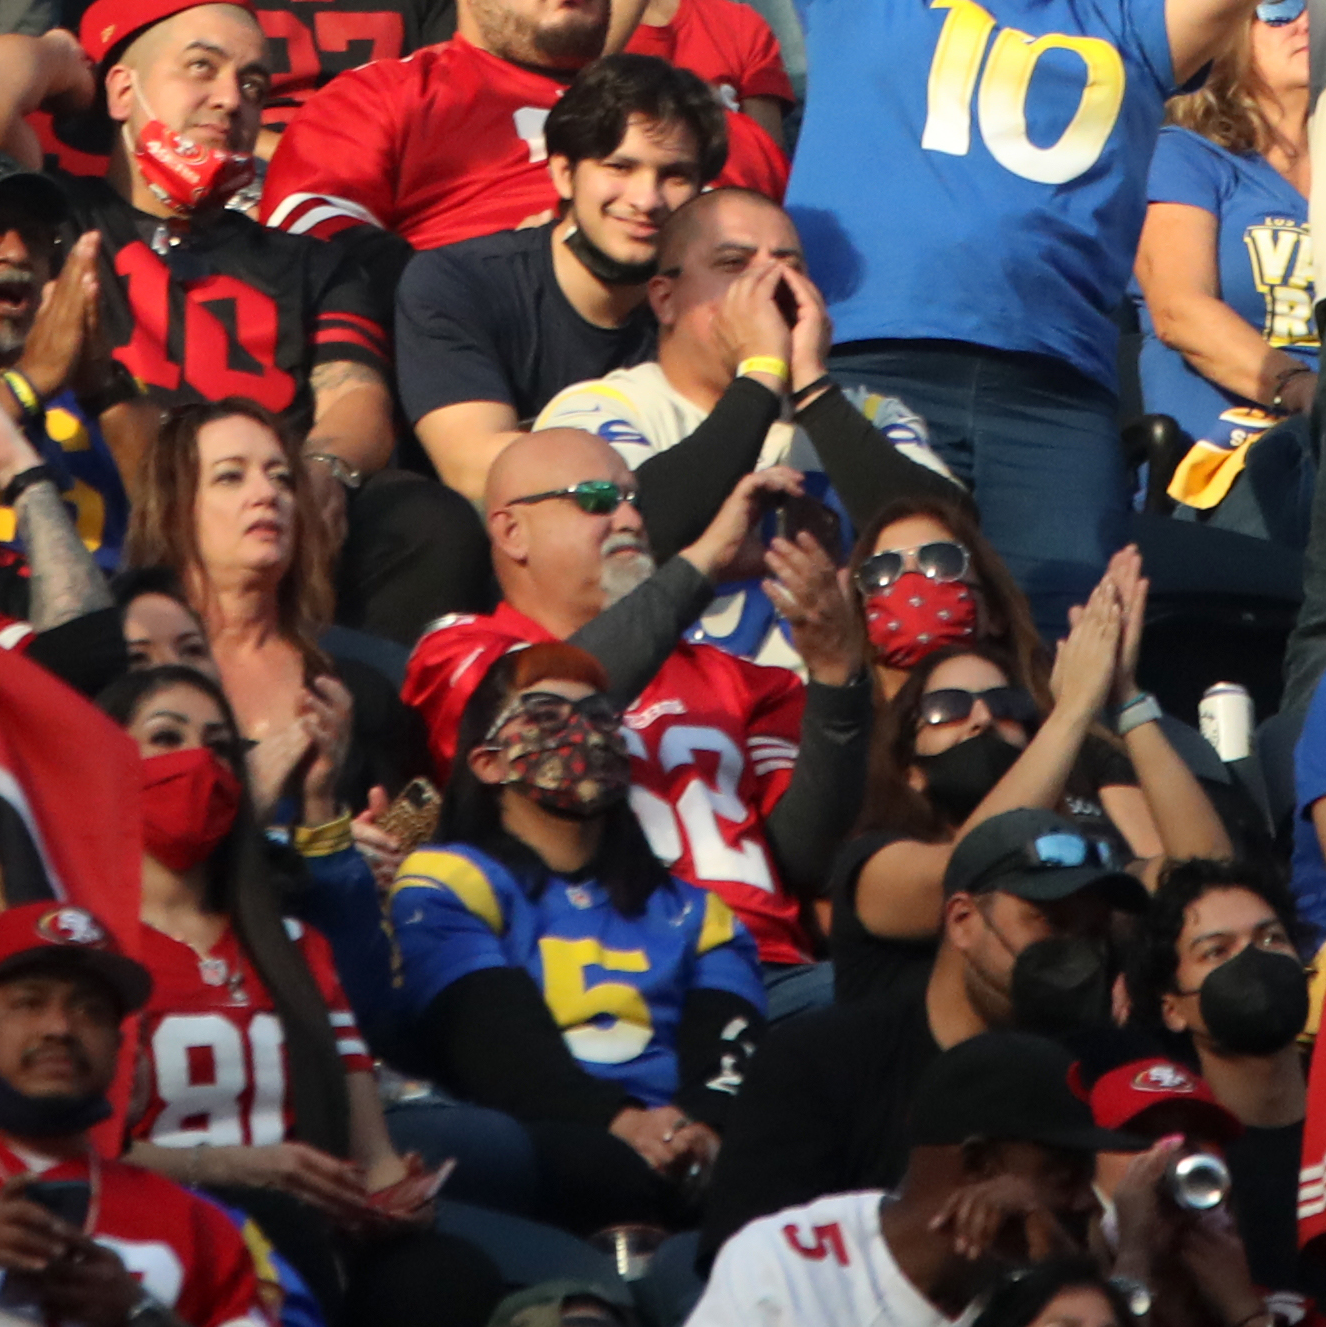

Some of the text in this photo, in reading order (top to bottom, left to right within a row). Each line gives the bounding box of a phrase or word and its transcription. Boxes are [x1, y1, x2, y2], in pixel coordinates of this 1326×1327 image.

[111, 239, 297, 415] 10
[538, 936, 655, 1065] 5
[151, 1013, 286, 1148] 81
[782, 1222, 850, 1267] 5
